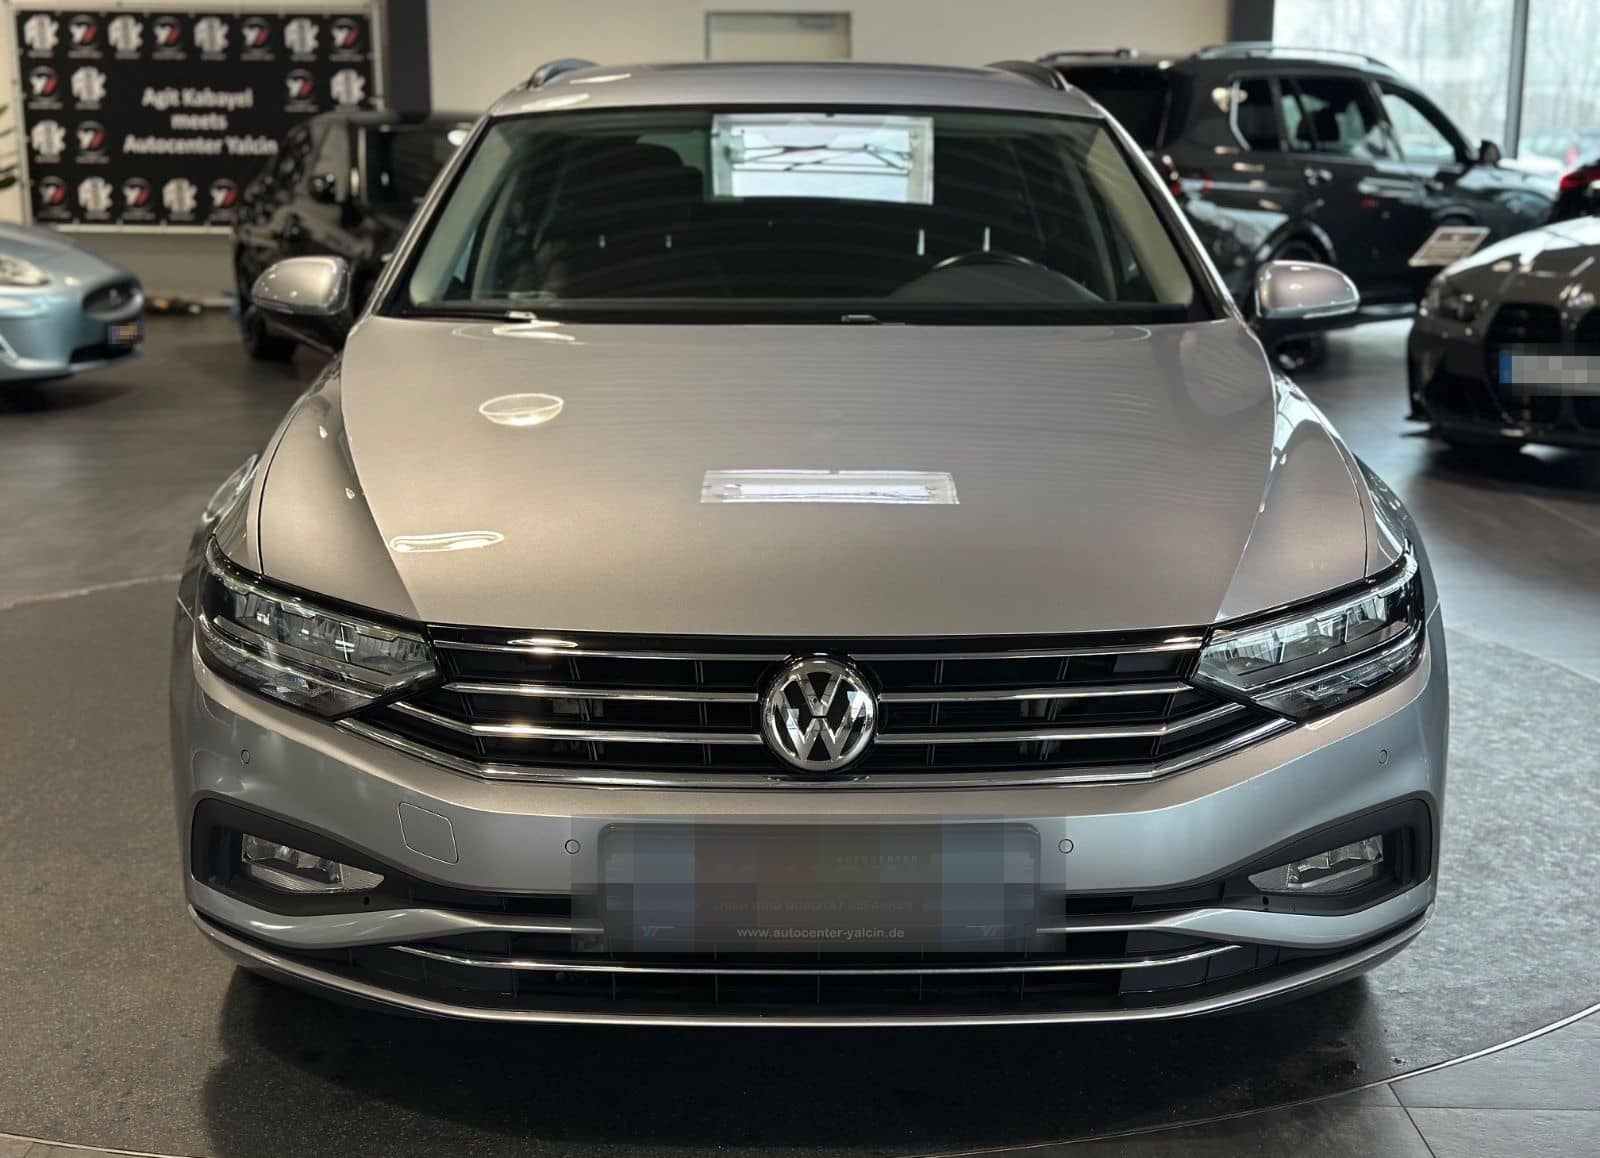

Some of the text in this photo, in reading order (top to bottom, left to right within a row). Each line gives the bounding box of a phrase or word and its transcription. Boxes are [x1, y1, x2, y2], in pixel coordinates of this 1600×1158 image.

[142, 87, 180, 110] Agit
[171, 113, 229, 130] meets
[124, 134, 222, 154] Autocenter
[737, 926, 905, 940] www.autocenter-yalcin.de
